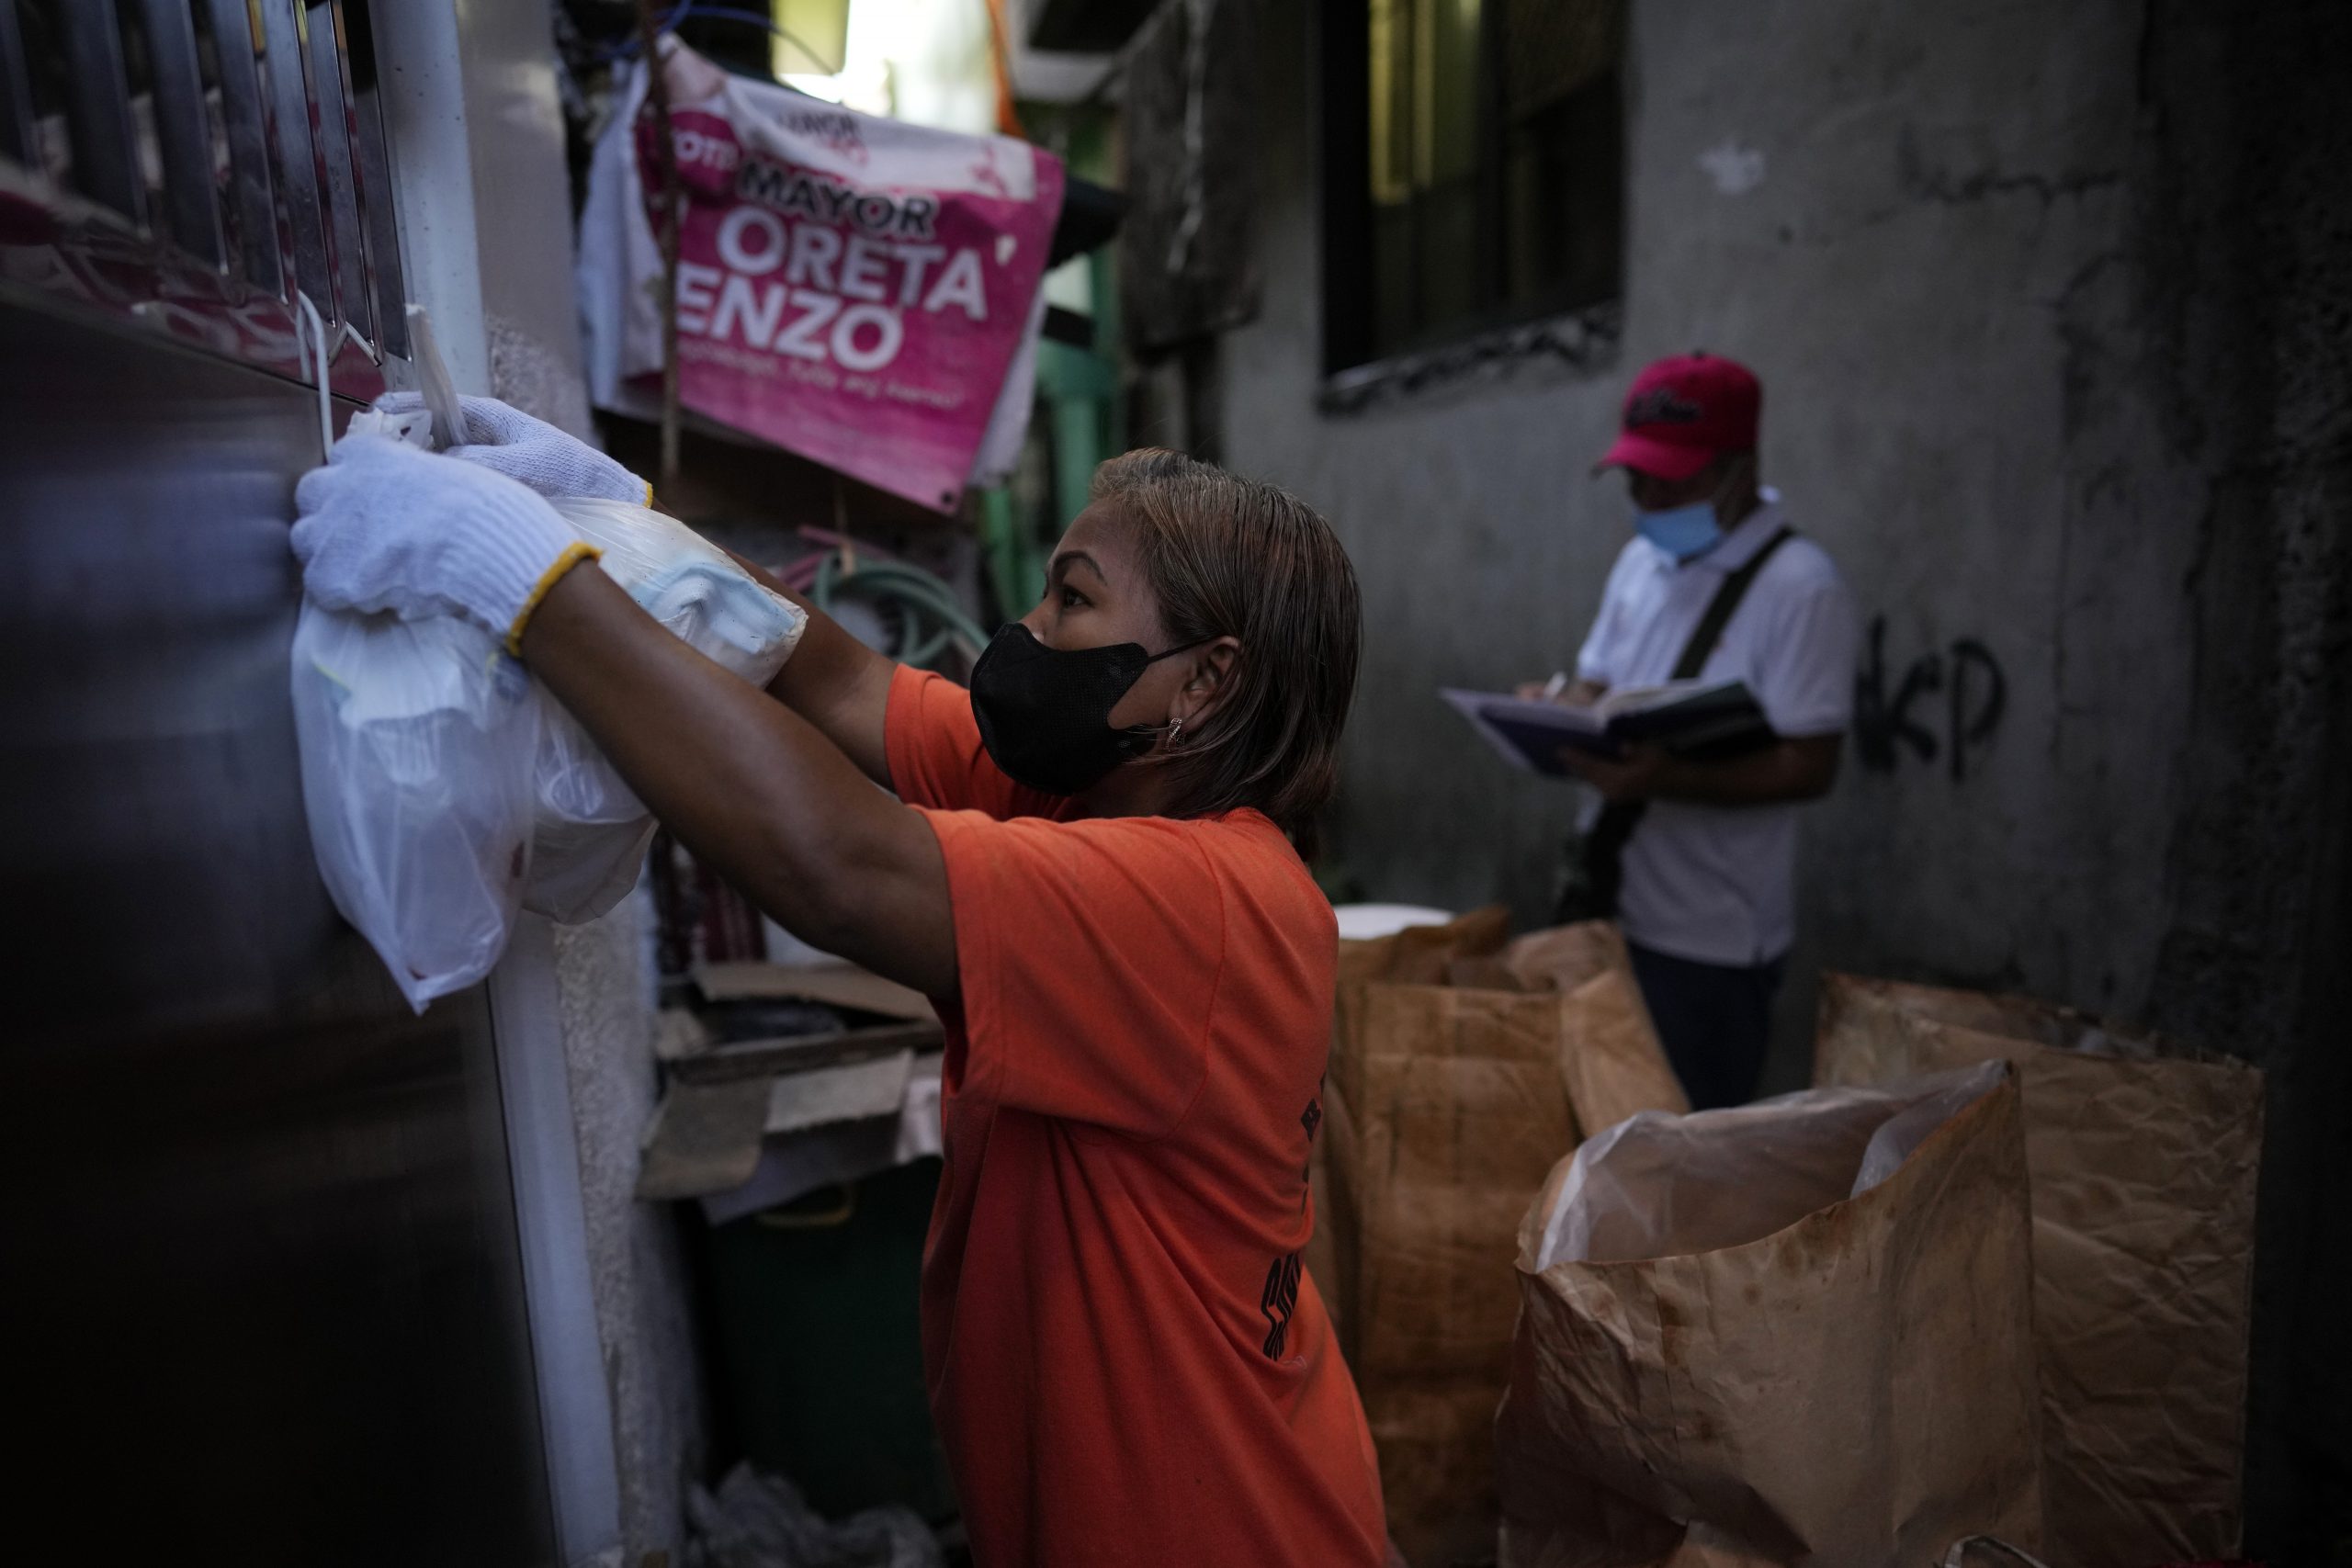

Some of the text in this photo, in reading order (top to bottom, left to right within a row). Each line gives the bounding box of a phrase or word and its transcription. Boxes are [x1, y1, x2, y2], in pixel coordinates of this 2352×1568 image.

[672, 129, 738, 172] OTE
[739, 160, 937, 240] MAYOR
[718, 207, 988, 321] ORETA
[676, 261, 902, 370] ENZO
